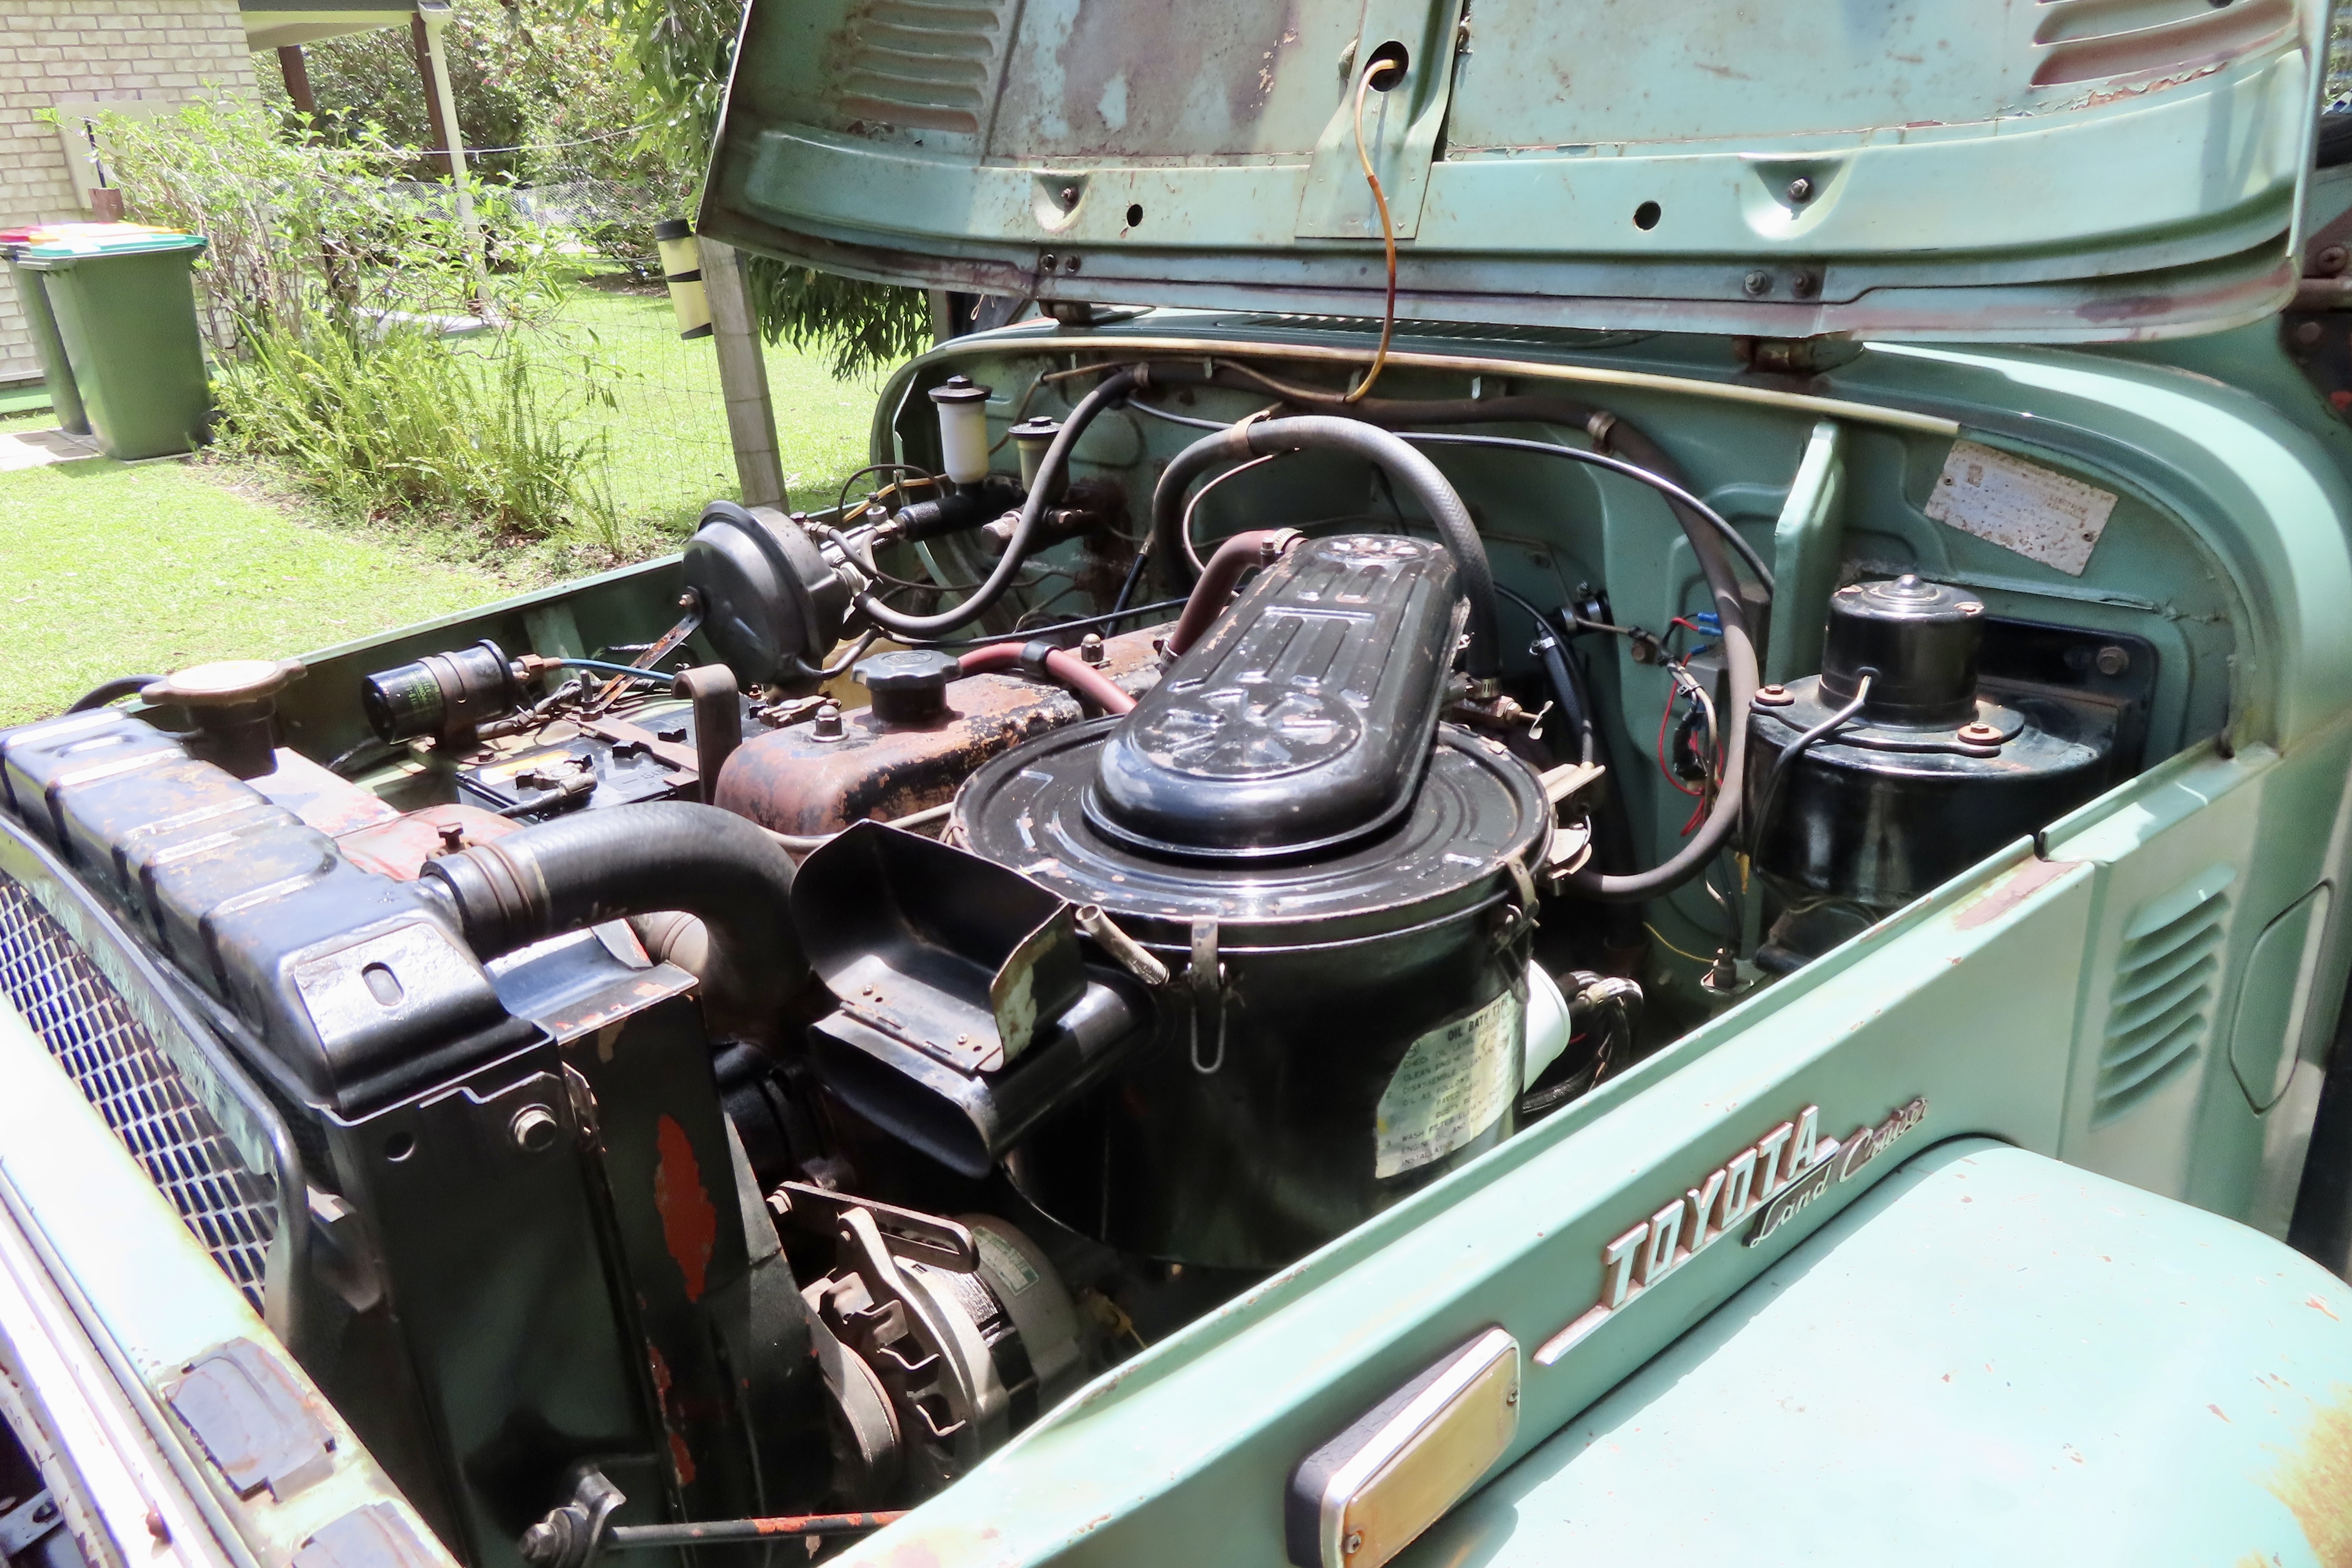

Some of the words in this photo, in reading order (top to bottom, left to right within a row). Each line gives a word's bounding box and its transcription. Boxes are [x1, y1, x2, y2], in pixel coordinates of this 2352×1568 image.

[1447, 1026, 1463, 1042] OIL
[1469, 1009, 1490, 1033] BATH
[1492, 998, 1508, 1016] TYPE
[1403, 1068, 1431, 1081] CLEAN
[1435, 1054, 1461, 1070] ENGINE
[1403, 1068, 1457, 1094] DISASSEMBLE
[1403, 1097, 1416, 1107] OIL
[1421, 1092, 1432, 1101] AS
[1436, 1091, 1460, 1106] PAVED
[1436, 1103, 1459, 1119] DUSTY
[1401, 1139, 1430, 1155] ENGINE
[1436, 1132, 1448, 1142] OIL
[1452, 1122, 1466, 1134] AND
[1402, 1131, 1424, 1142] WASH
[1429, 1116, 1455, 1134] FILTER
[1401, 1139, 1455, 1166] INSTALLATION
[1748, 1163, 1834, 1250] Land
[1838, 1097, 1930, 1184] Cruiser
[1602, 1104, 1820, 1310] TOYOTA
